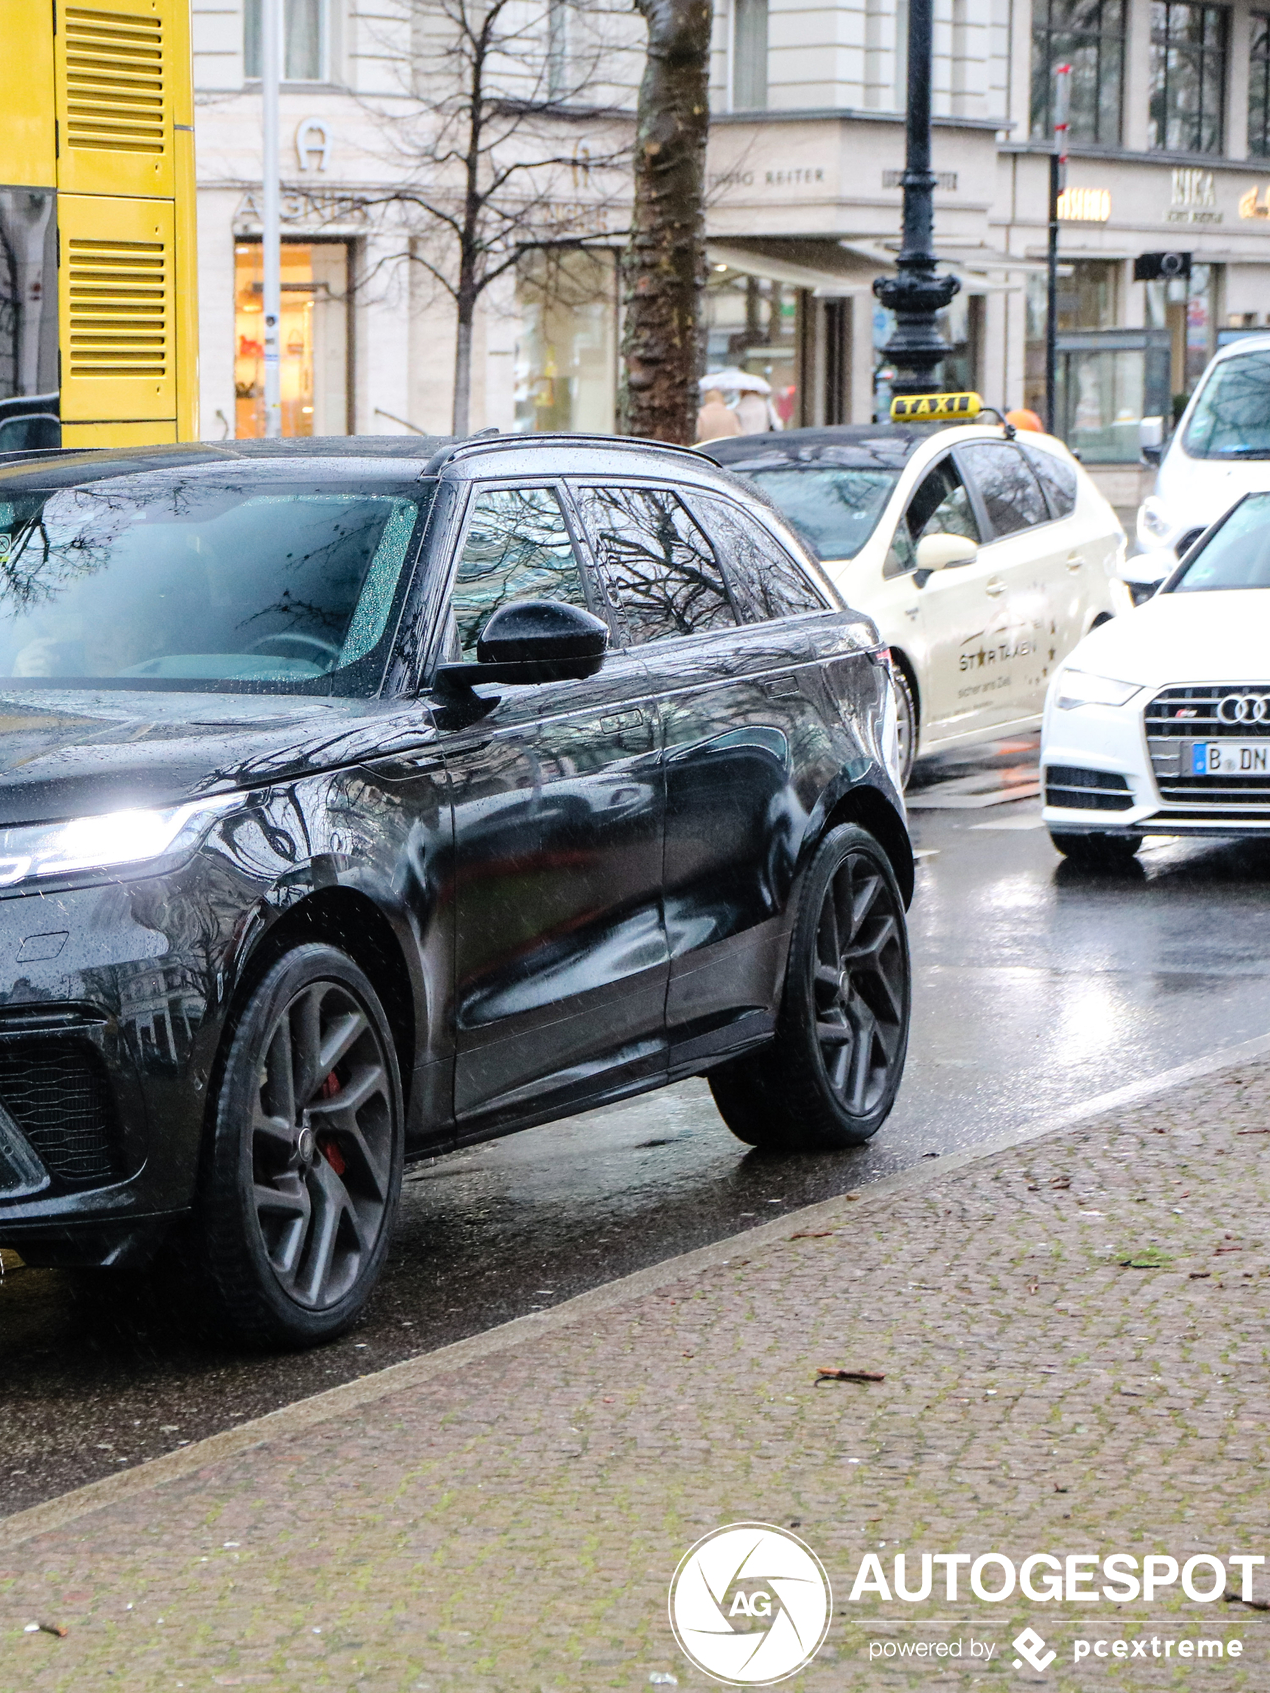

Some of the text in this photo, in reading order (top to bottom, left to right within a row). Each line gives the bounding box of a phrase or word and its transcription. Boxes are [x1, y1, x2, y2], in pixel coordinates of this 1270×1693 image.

[765, 167, 825, 186] REITER
[903, 397, 961, 414] TAXI
[1209, 748, 1267, 771] B DN
